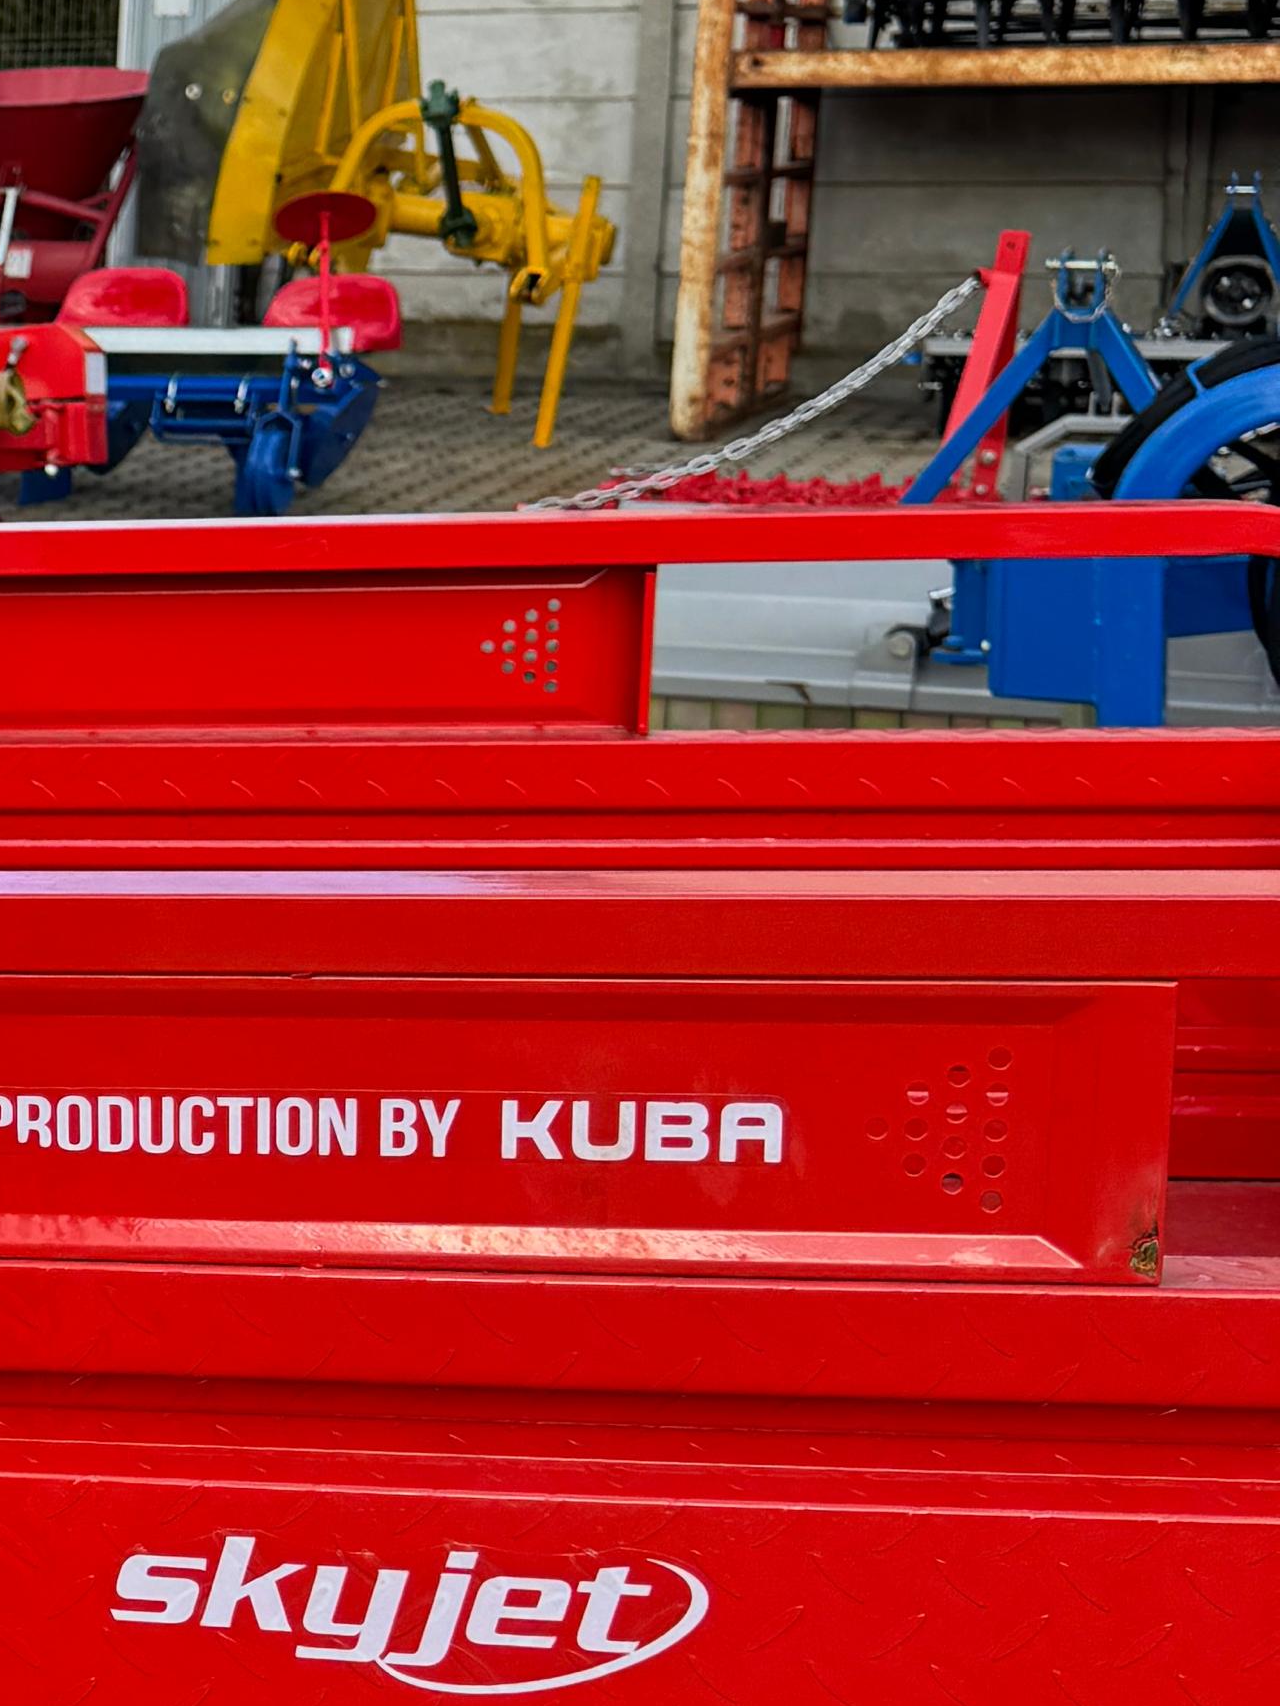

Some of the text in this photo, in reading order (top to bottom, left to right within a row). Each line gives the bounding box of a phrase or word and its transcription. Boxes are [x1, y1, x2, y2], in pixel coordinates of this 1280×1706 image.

[379, 1098, 462, 1158] BY
[500, 1099, 784, 1163] KUBA
[109, 1536, 678, 1681] skyjet
